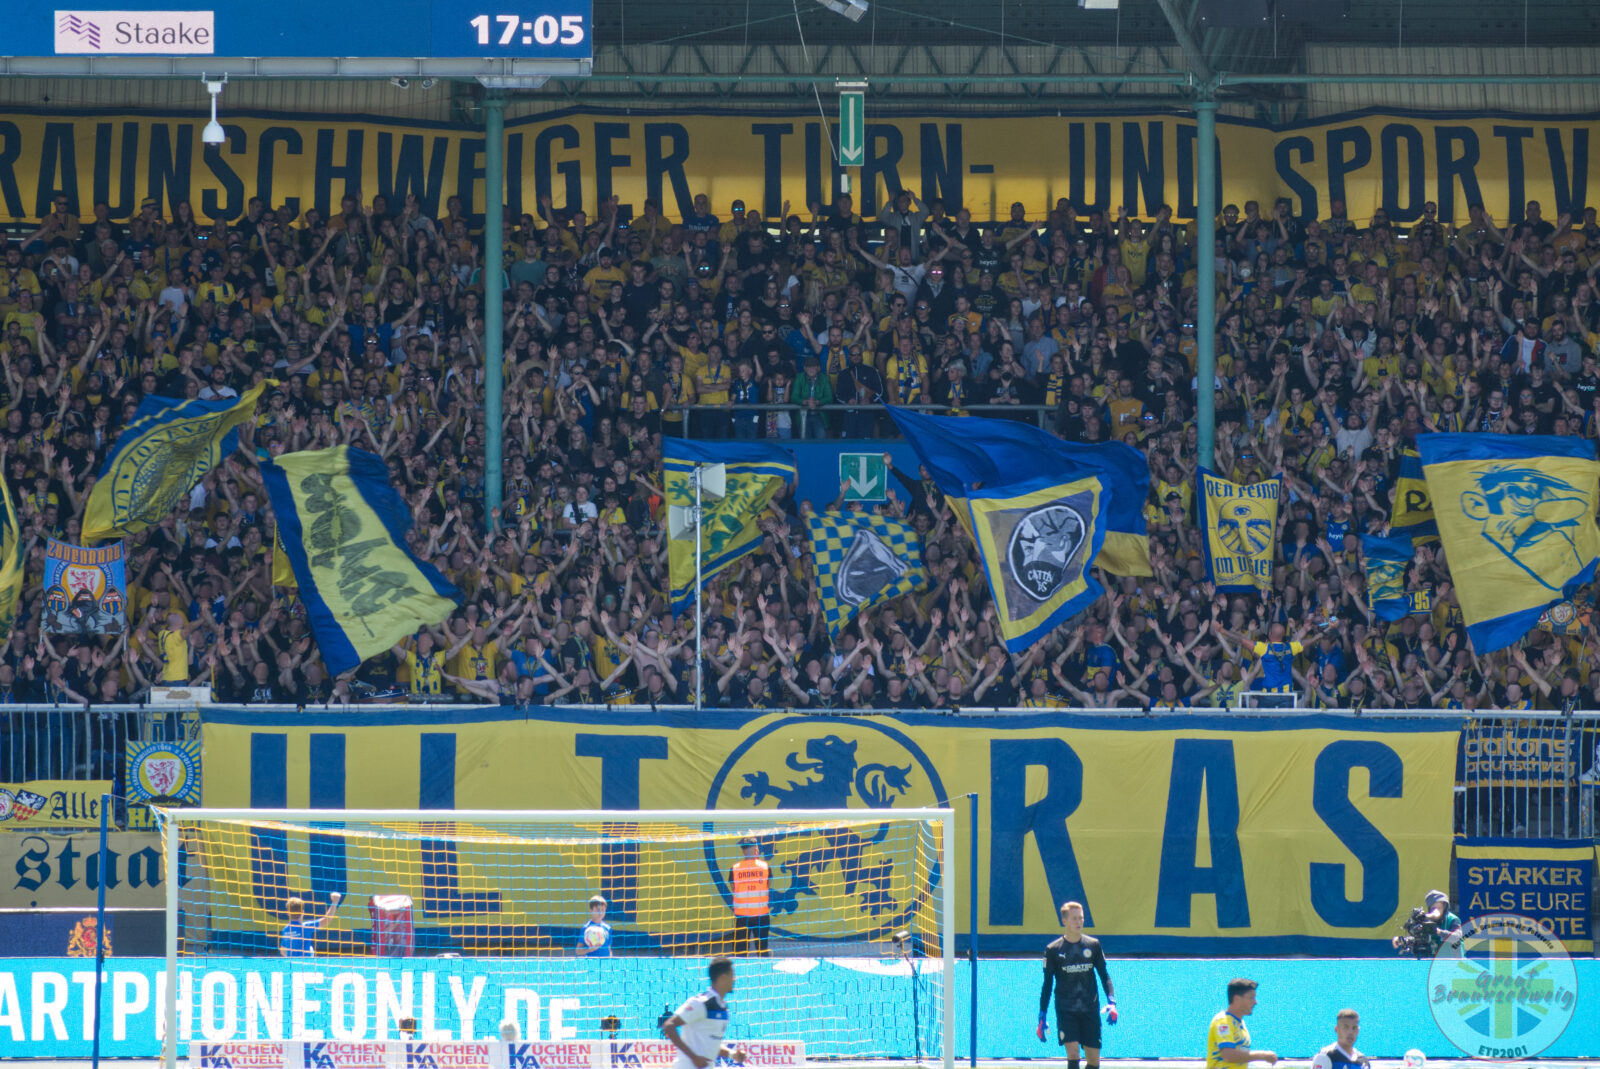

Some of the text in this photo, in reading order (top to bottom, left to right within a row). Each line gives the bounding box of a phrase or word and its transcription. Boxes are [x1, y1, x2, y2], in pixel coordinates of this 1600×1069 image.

[115, 21, 210, 45] Staake
[470, 14, 585, 46] 17:05
[1069, 121, 1222, 219] UND
[1274, 124, 1590, 226] SPORTV
[1414, 590, 1430, 610] 95
[1468, 863, 1583, 886] STÄRKER
[1468, 892, 1586, 911] ALS EURE
[1469, 916, 1586, 936] VERBOTE
